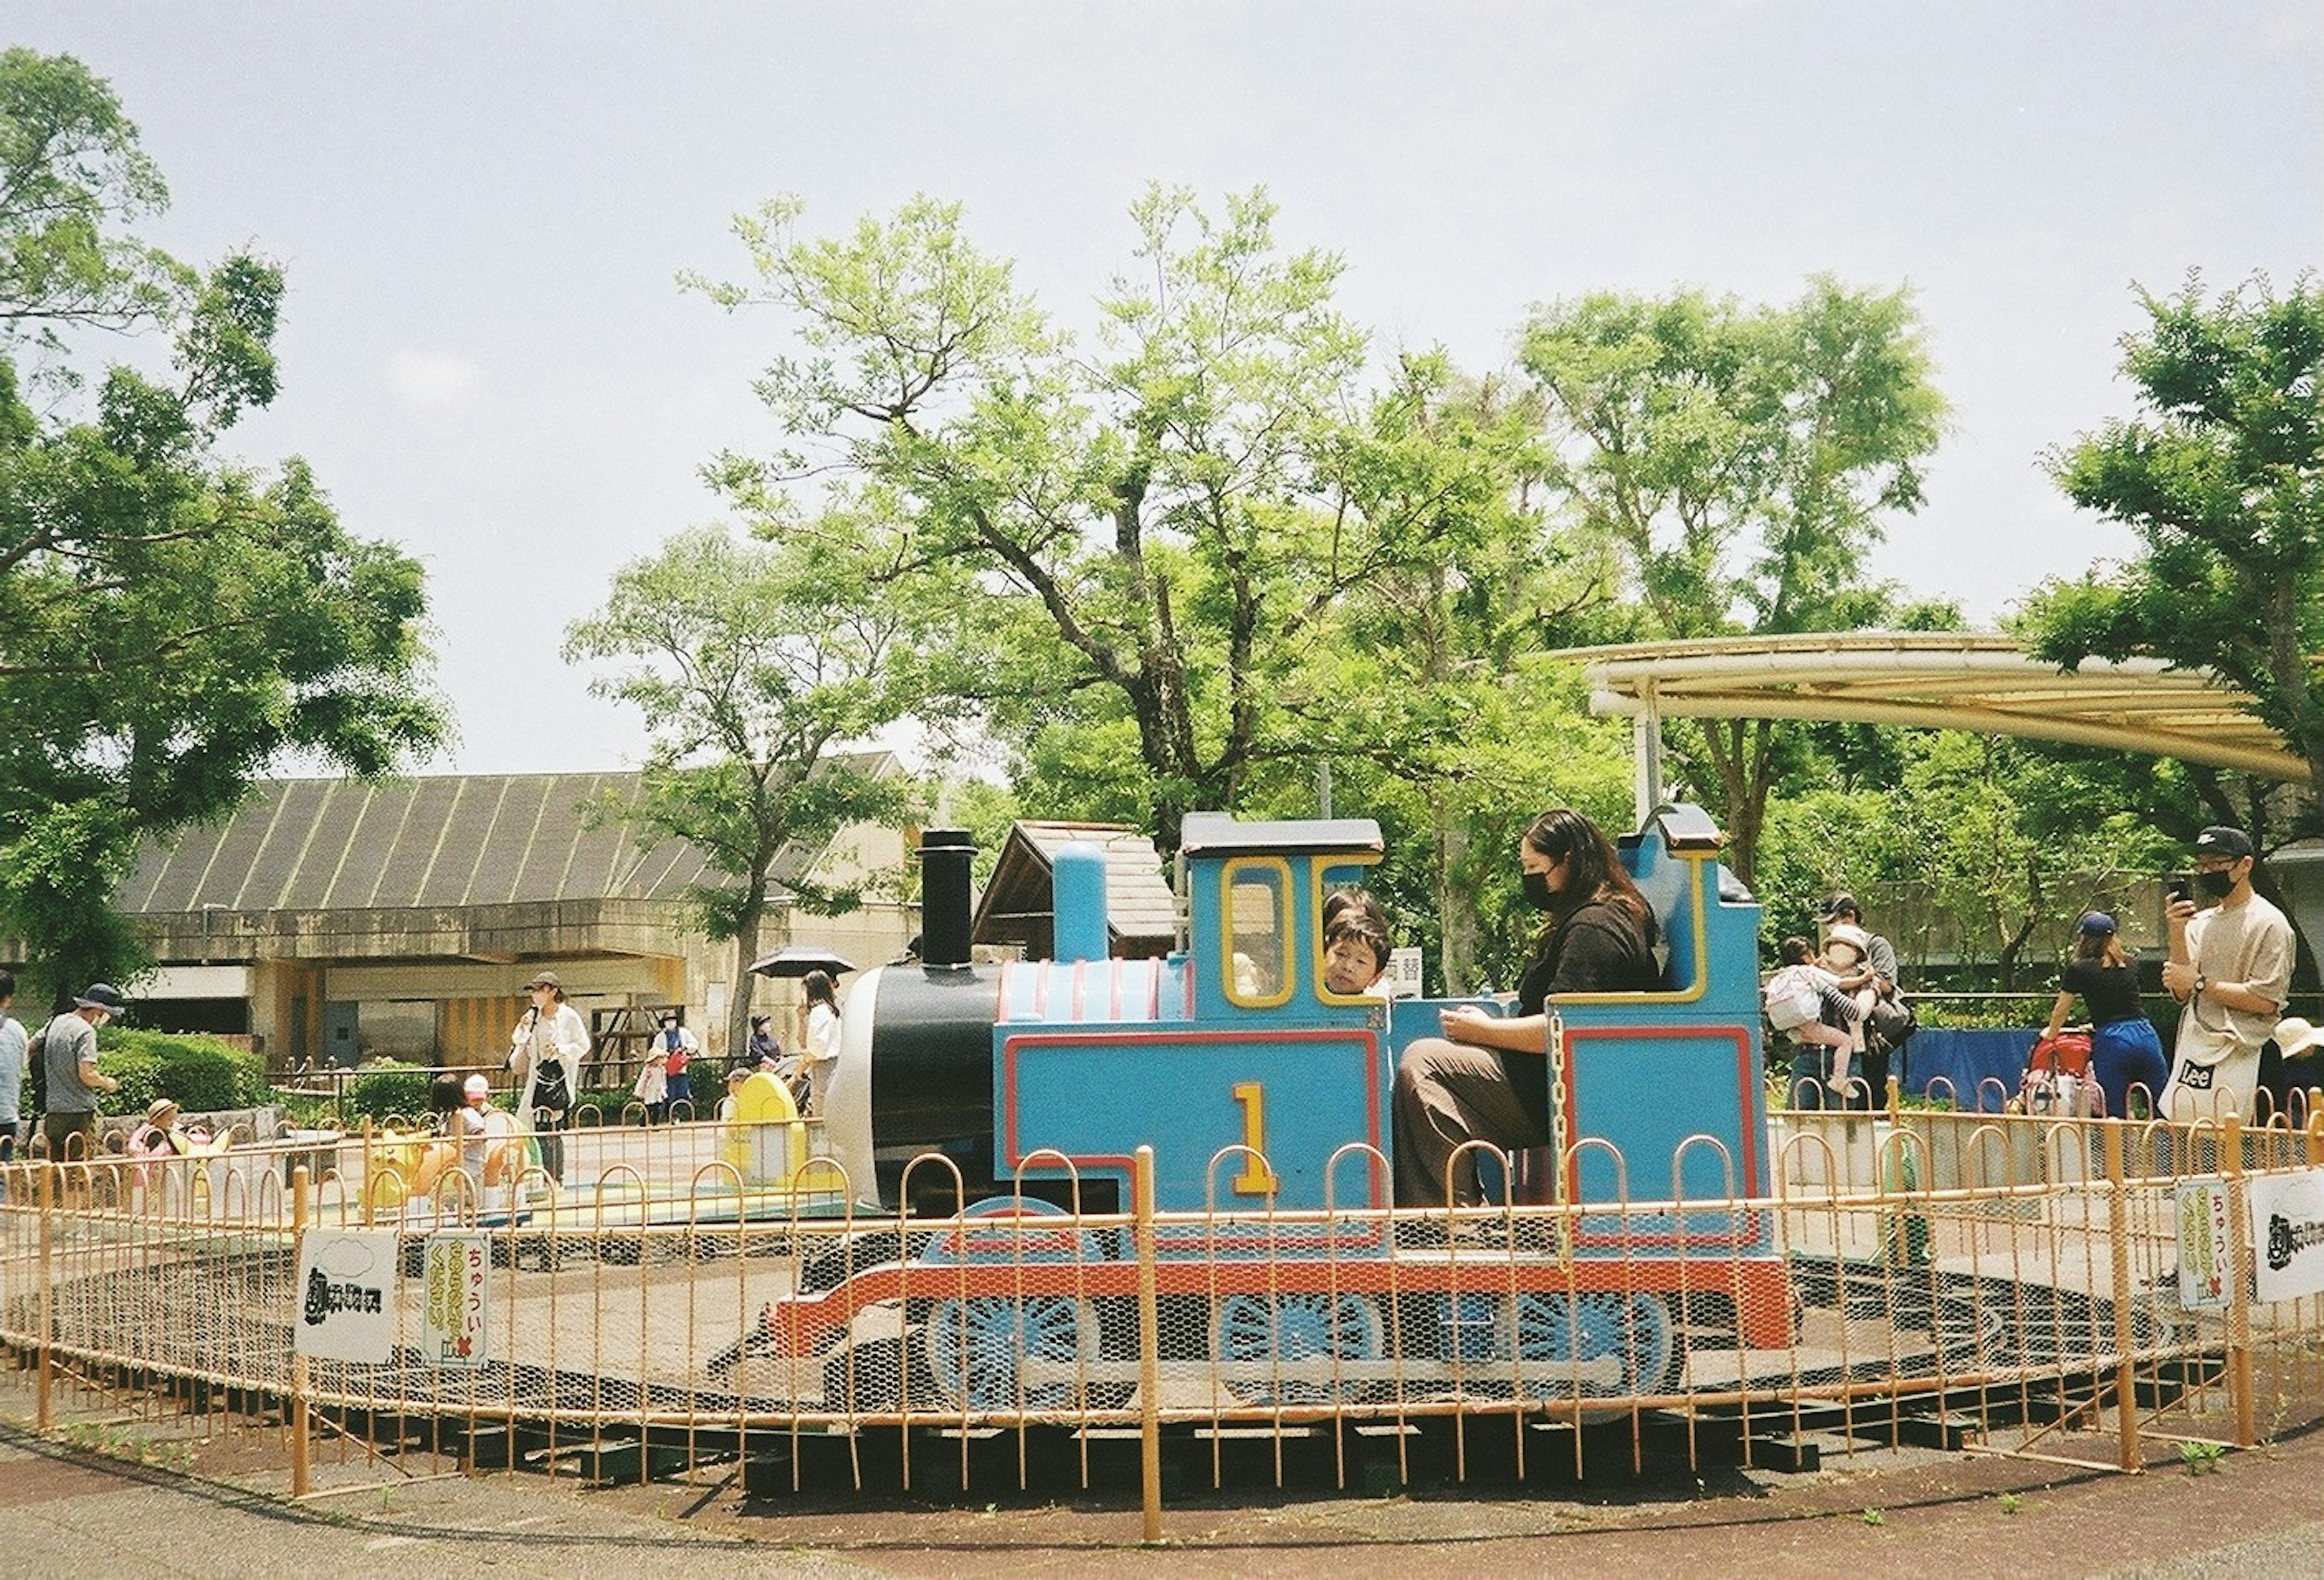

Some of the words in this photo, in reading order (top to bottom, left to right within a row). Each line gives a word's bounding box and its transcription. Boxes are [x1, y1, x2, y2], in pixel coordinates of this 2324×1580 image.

[2181, 1063, 2210, 1087] Lee
[1232, 1082, 1278, 1195] 1
[2213, 1195, 2228, 1273] ちゅうい
[447, 1239, 465, 1337] さわらないで
[468, 1248, 483, 1333] ちゅうい
